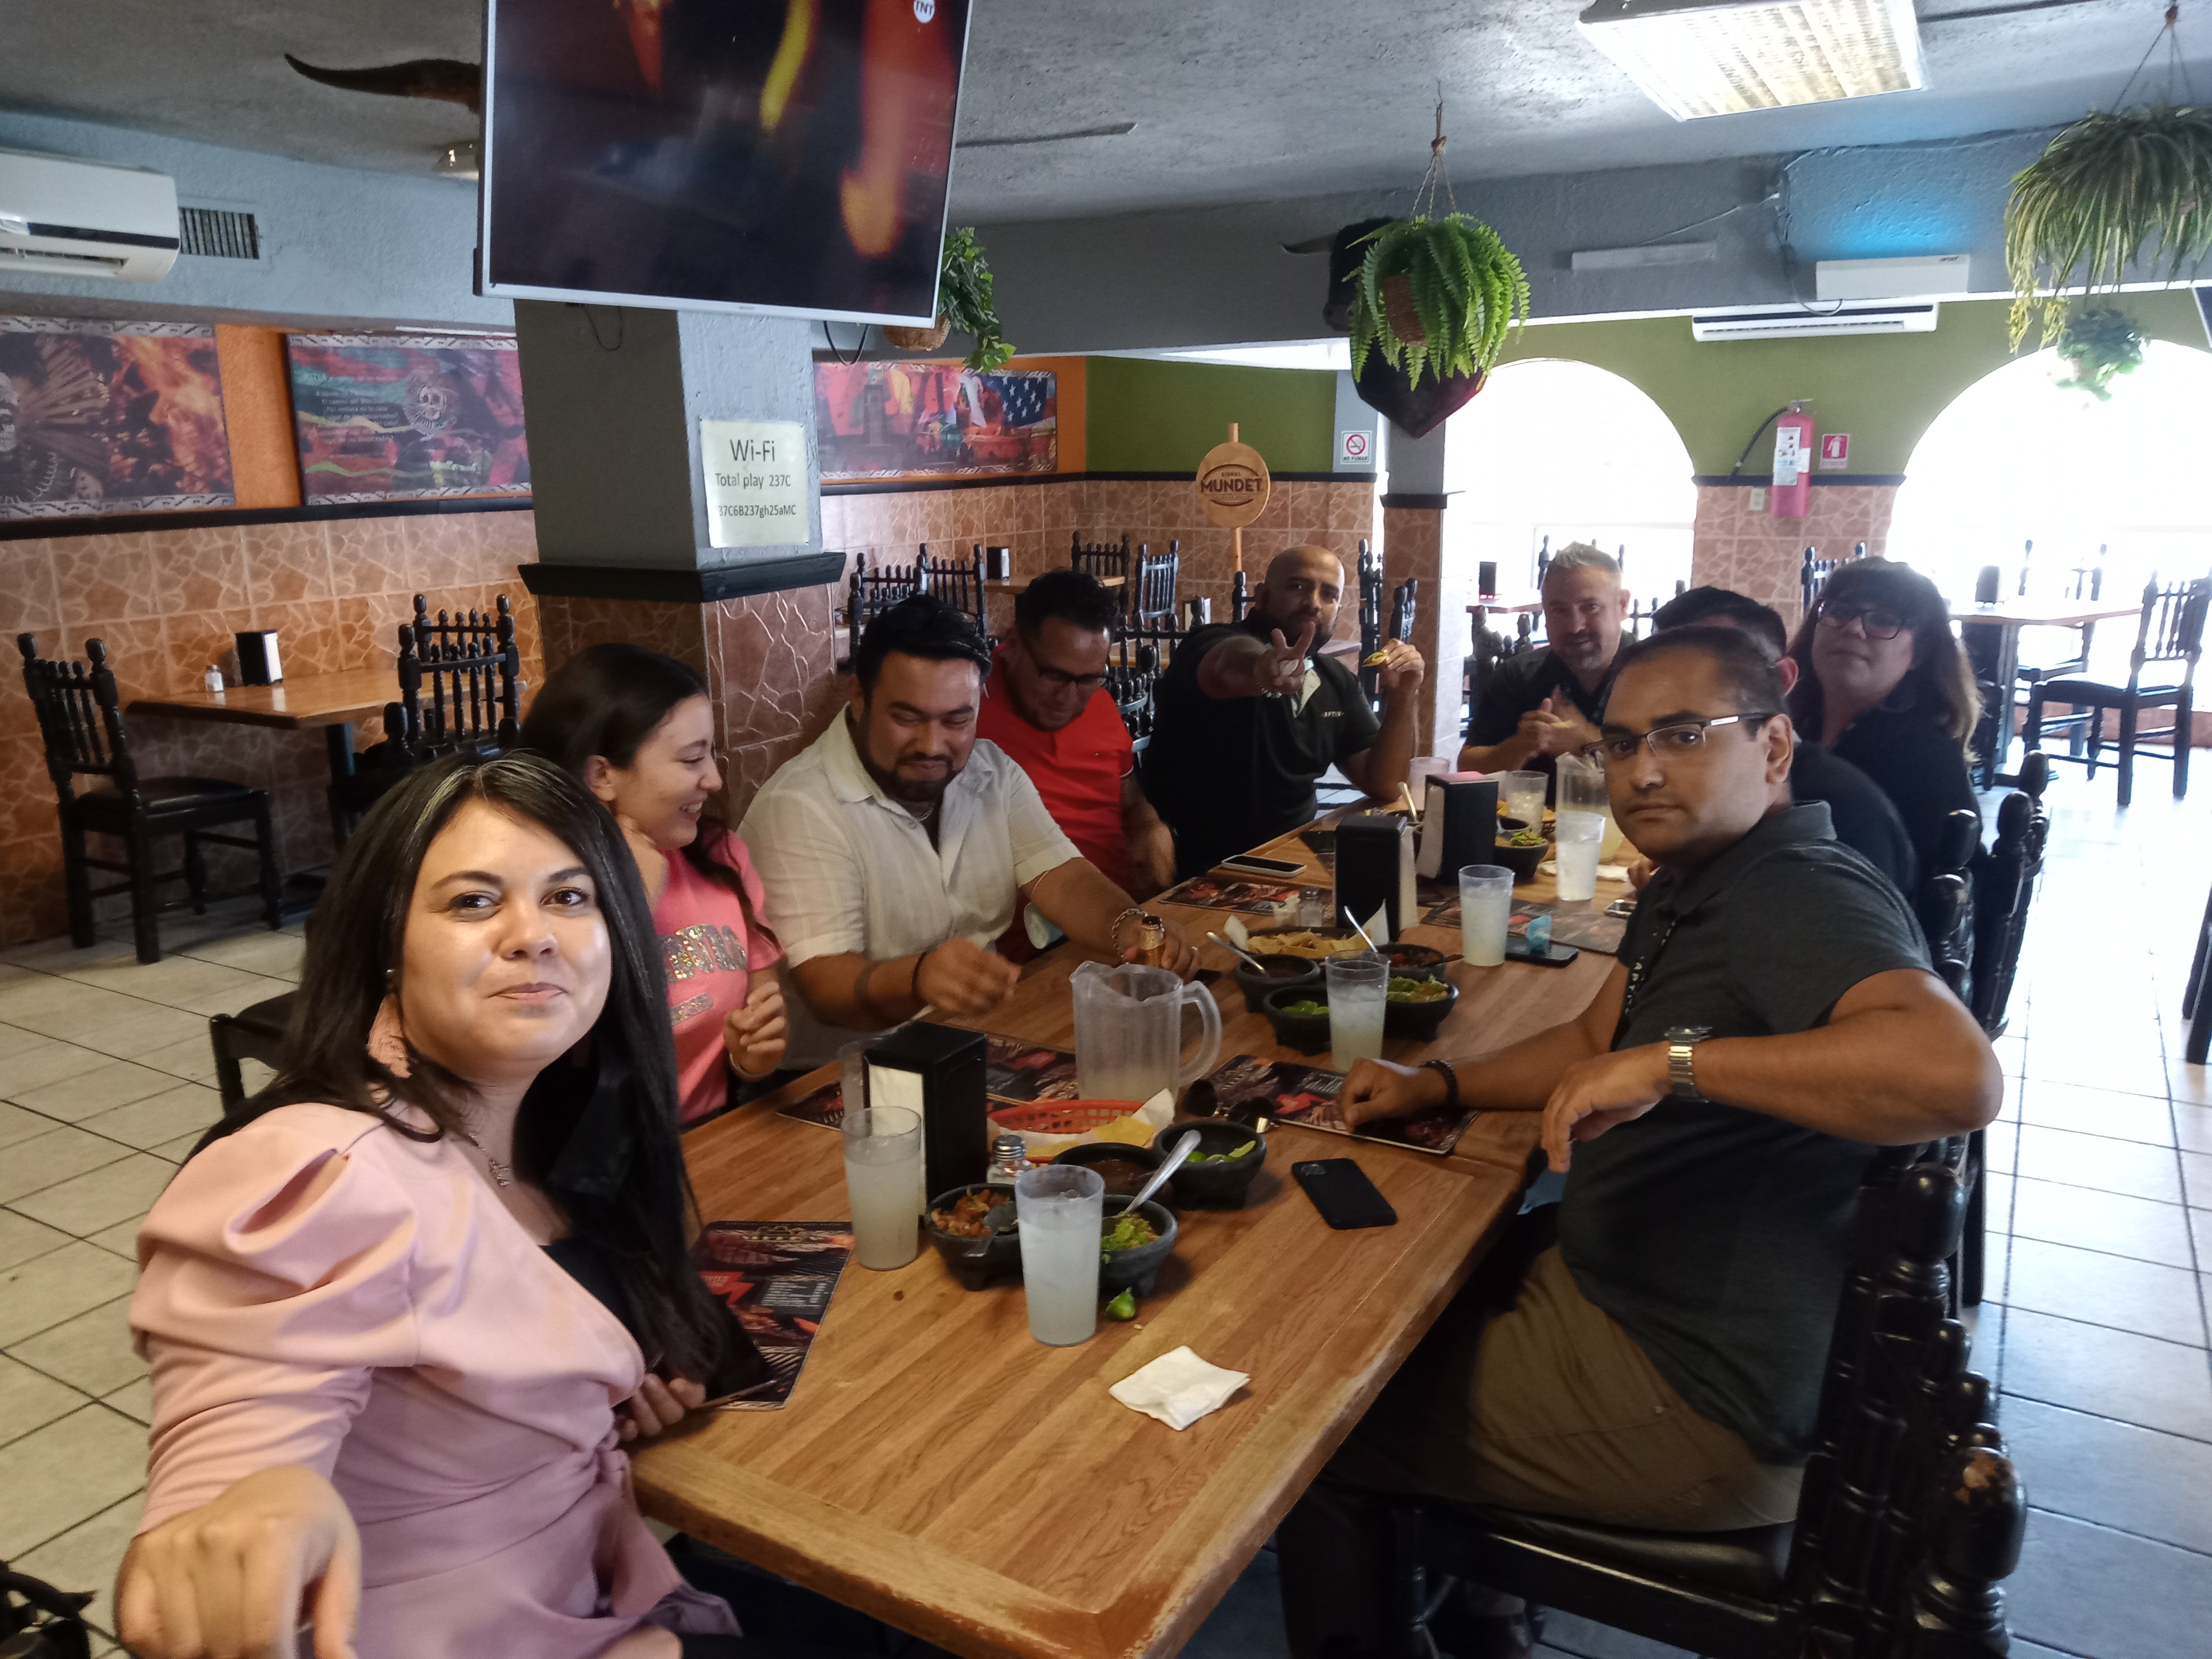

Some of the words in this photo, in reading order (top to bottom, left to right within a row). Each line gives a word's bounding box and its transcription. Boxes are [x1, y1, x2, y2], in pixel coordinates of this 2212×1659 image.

[916, 1, 934, 16] TNT
[730, 439, 775, 462] Wi-Fi
[715, 473, 740, 487] Total
[743, 473, 764, 489] play
[769, 474, 791, 487] 237C
[1200, 478, 1262, 492] MUNDET
